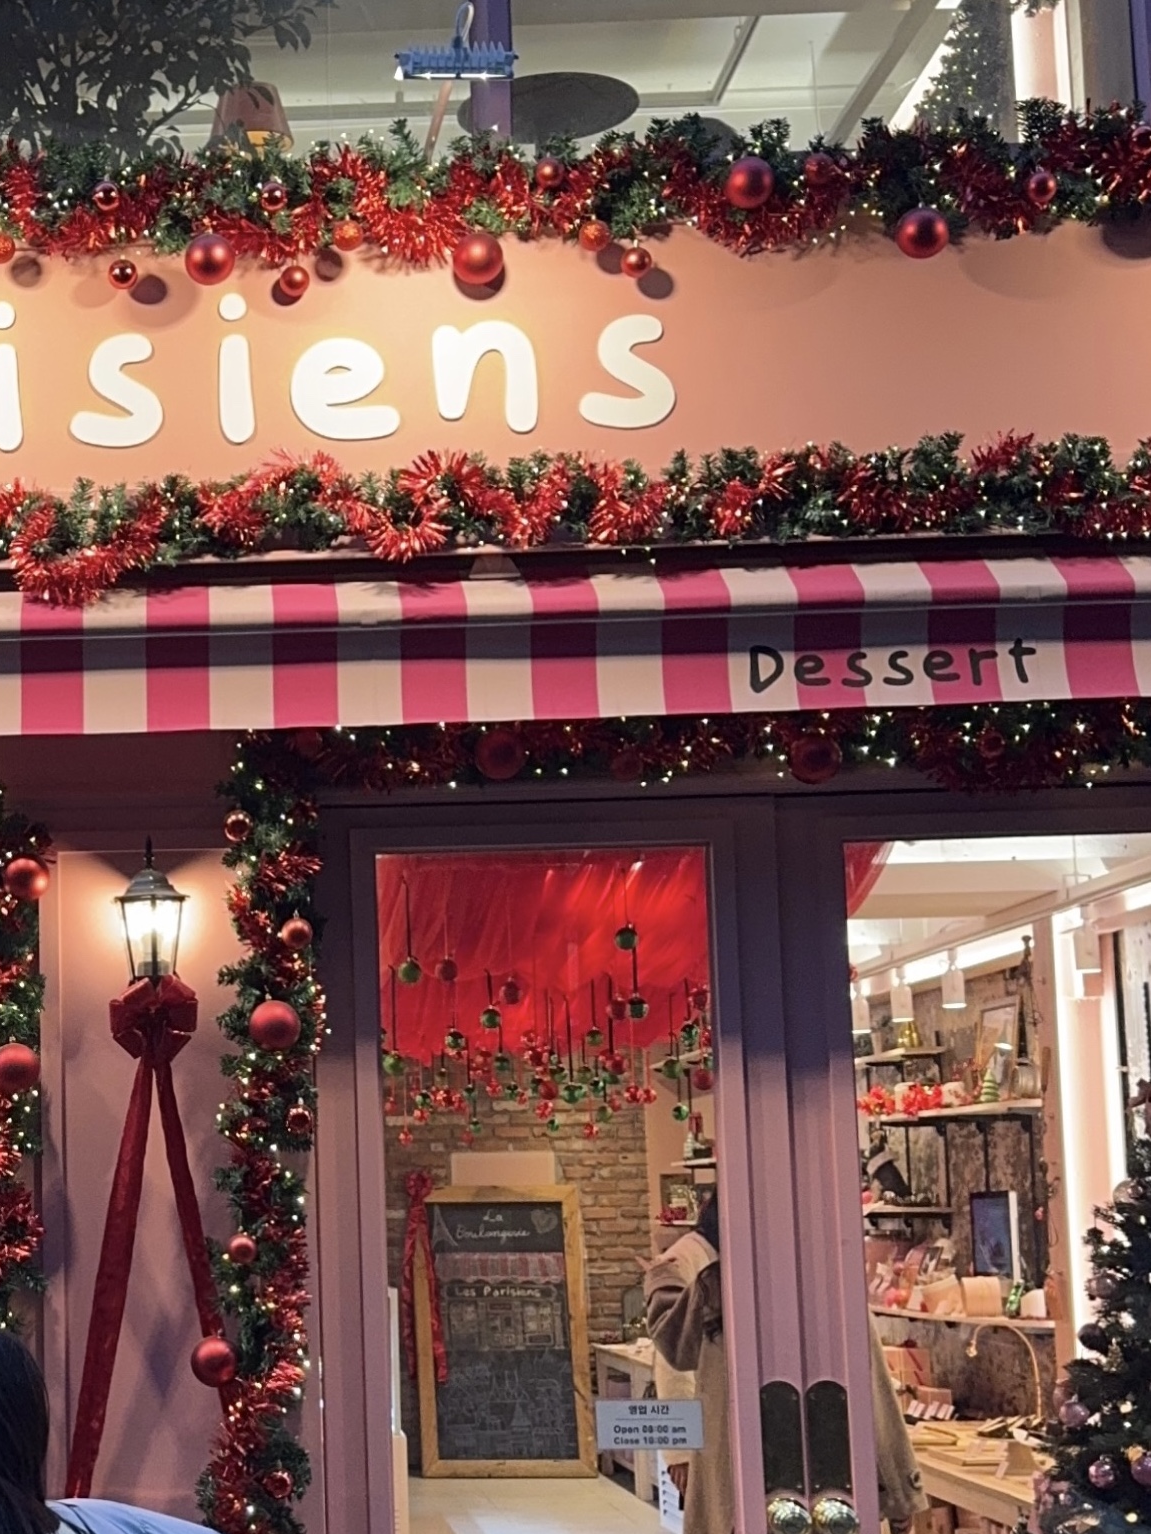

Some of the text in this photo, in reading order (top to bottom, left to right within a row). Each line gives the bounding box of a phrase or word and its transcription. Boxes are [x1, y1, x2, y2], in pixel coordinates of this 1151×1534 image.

[750, 637, 1037, 694] Dessert
[454, 1285, 541, 1298] Les Parisiens
[628, 1405, 669, 1415] 영업 시간
[613, 1425, 639, 1434] Open
[671, 1426, 686, 1434] am
[613, 1436, 640, 1445] Close
[672, 1437, 687, 1445] pm
